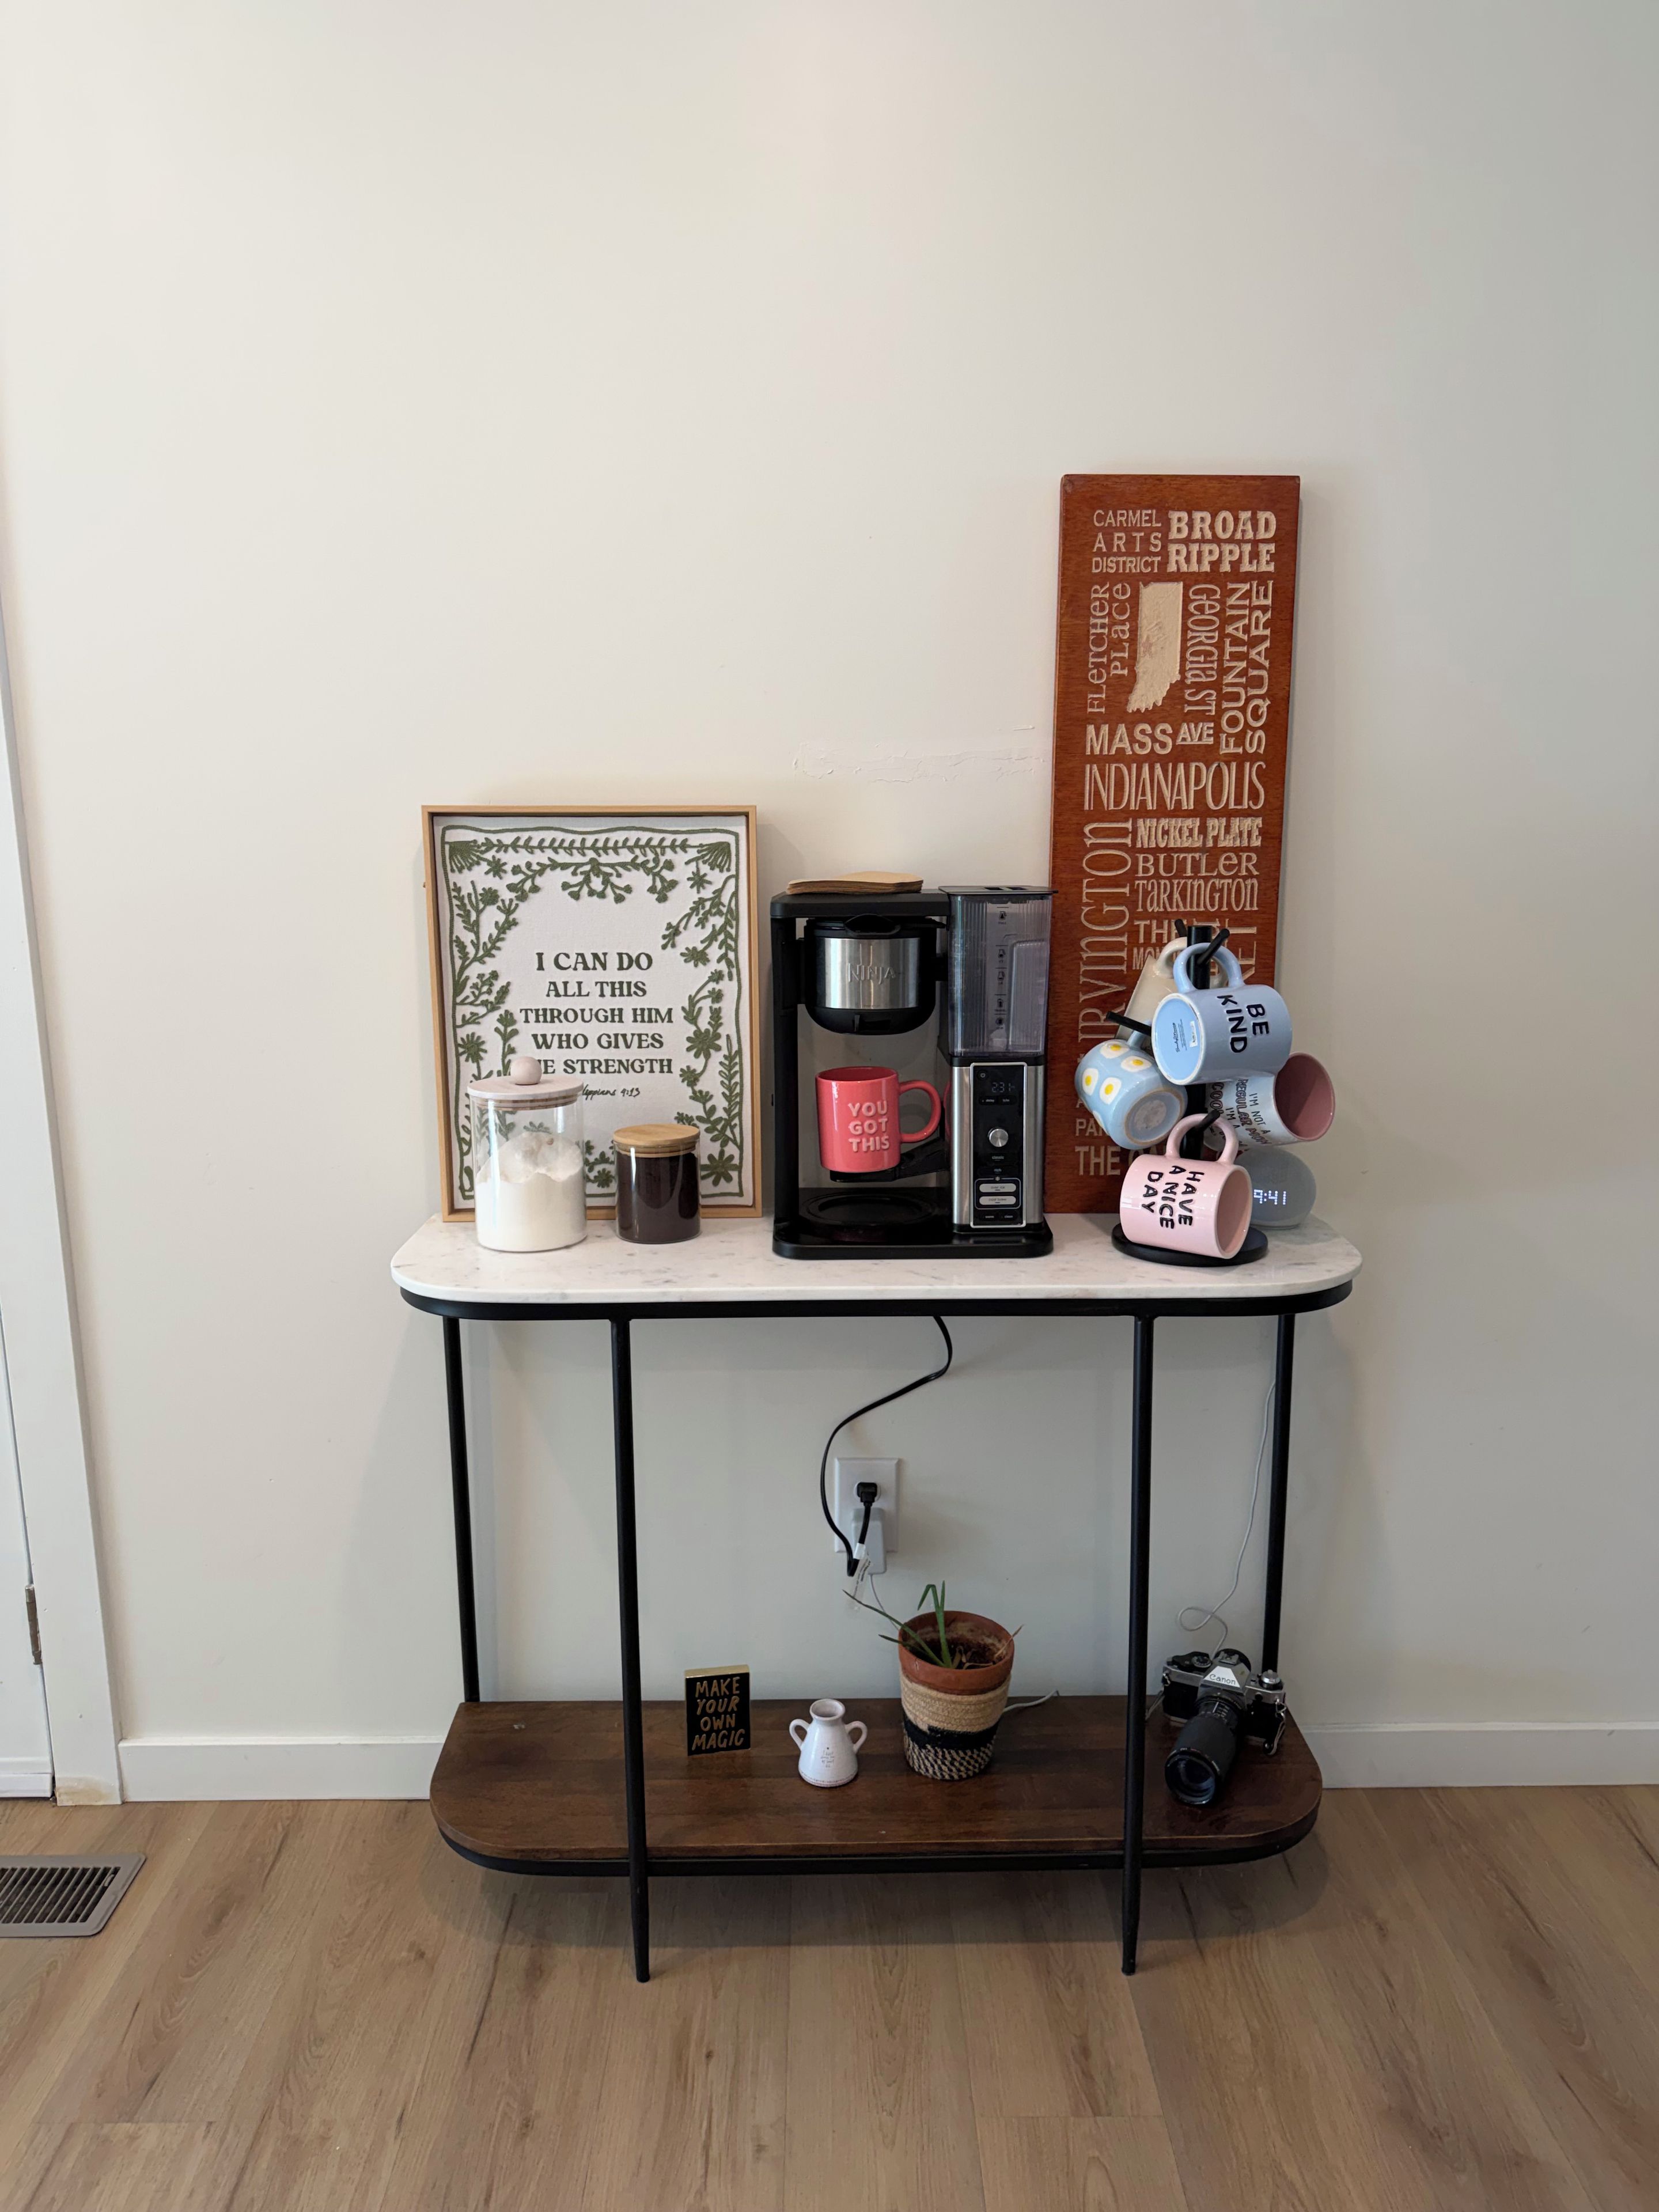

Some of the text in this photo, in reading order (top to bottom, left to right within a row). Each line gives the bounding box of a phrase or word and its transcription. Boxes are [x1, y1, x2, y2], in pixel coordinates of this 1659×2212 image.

[1094, 509, 1161, 527] CARMEL
[1168, 510, 1276, 540] BROAD
[1092, 532, 1161, 552] ARTS
[1092, 556, 1161, 573] DISTRICT
[1167, 543, 1275, 573] RIPPLE
[1219, 582, 1250, 754] FOUNTAIN
[1245, 580, 1273, 754] SQUARE
[1184, 689, 1217, 715] ST
[1086, 722, 1214, 755] MASS AVE
[1084, 762, 1266, 810] INDIANAPOLIS
[1136, 817, 1262, 848] NICKEL PLATE
[536, 952, 653, 971] I CAN DO
[848, 963, 896, 985] NINJA
[546, 980, 647, 998] ALL THIS
[520, 1007, 673, 1024] THROUGH HIM
[1217, 995, 1248, 1054] KIND
[1246, 1003, 1270, 1035] BE
[531, 1033, 664, 1050] WHO GIVES
[563, 1058, 673, 1074] STRENGTH
[848, 1101, 887, 1117] YOU
[1235, 1078, 1253, 1126] REGULAR
[1249, 1093, 1259, 1107] I'M
[848, 1118, 888, 1135] GOT
[1251, 1111, 1266, 1125] NOT
[848, 1135, 889, 1152] THIS
[1075, 1146, 1121, 1176] THE
[1142, 1171, 1164, 1213] DAY
[1159, 1165, 1187, 1229] A NICE
[1178, 1171, 1205, 1226] HAVE
[1253, 1189, 1286, 1205] 9:41
[695, 1676, 740, 1698] MAKE
[1210, 1673, 1236, 1685] Canon
[696, 1695, 740, 1715] YOUR
[700, 1713, 736, 1732] OWN
[691, 1729, 745, 1751] MAGIC
